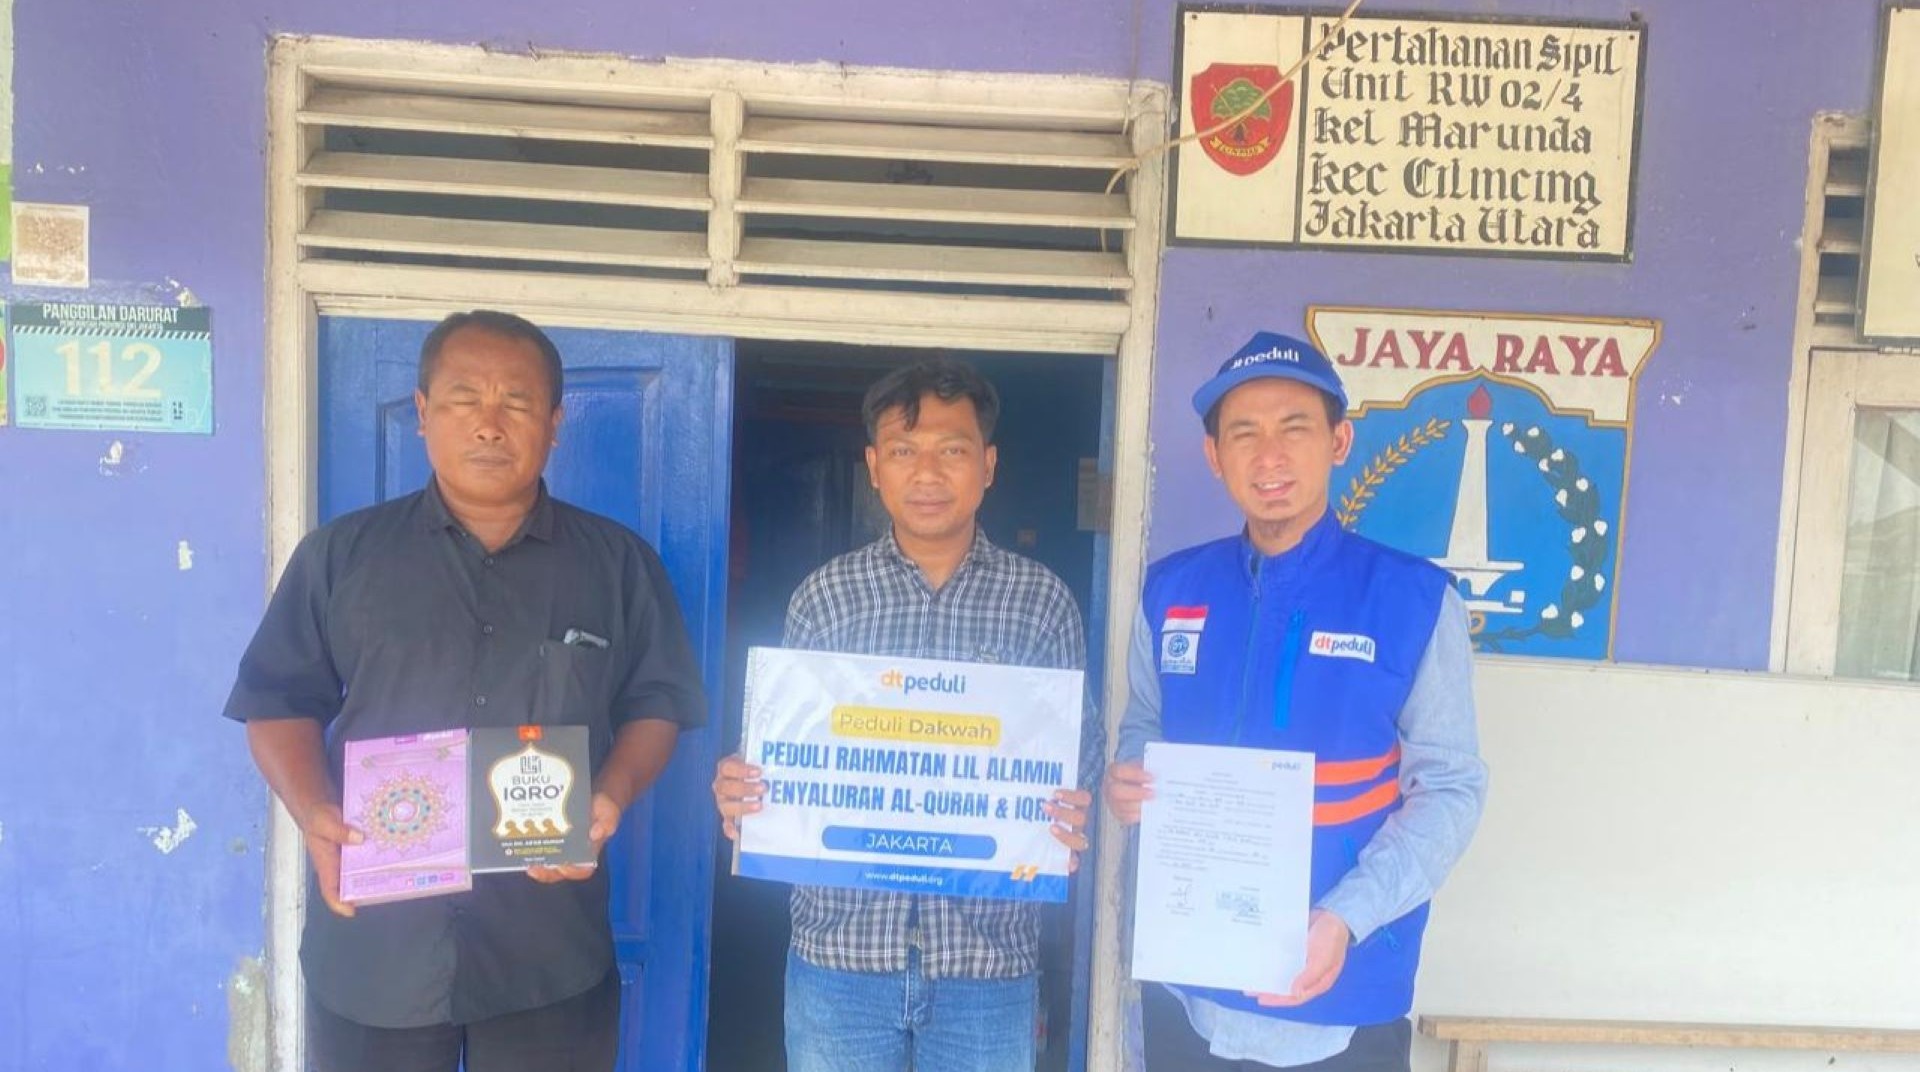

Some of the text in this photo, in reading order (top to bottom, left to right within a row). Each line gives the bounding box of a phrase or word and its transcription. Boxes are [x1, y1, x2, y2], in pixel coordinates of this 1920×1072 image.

[1317, 23, 1624, 76] Pertahanan Sipil
[1320, 66, 1584, 112] Unit RW 02/4
[1397, 112, 1593, 154] Marunda
[1402, 156, 1602, 215] Cilincing
[1305, 199, 1601, 249] Jakarta Utara
[43, 303, 178, 322] PANGGILAN DARURAT
[55, 340, 163, 399] 112
[1337, 328, 1628, 377] JAYA RAYA
[1314, 635, 1372, 656] dtpeduli
[880, 669, 966, 694] dtpeduli
[839, 714, 993, 741] Peduli Dakwah
[511, 775, 551, 785] BUKU
[761, 740, 1064, 786] PEDULI RAHMATAN LIL ALAMIN
[503, 784, 565, 801] IQRO'
[890, 788, 989, 816] AL-QURAN
[995, 798, 1009, 819] &
[1014, 794, 1053, 823] IQR
[866, 832, 953, 853] JAKARTA
